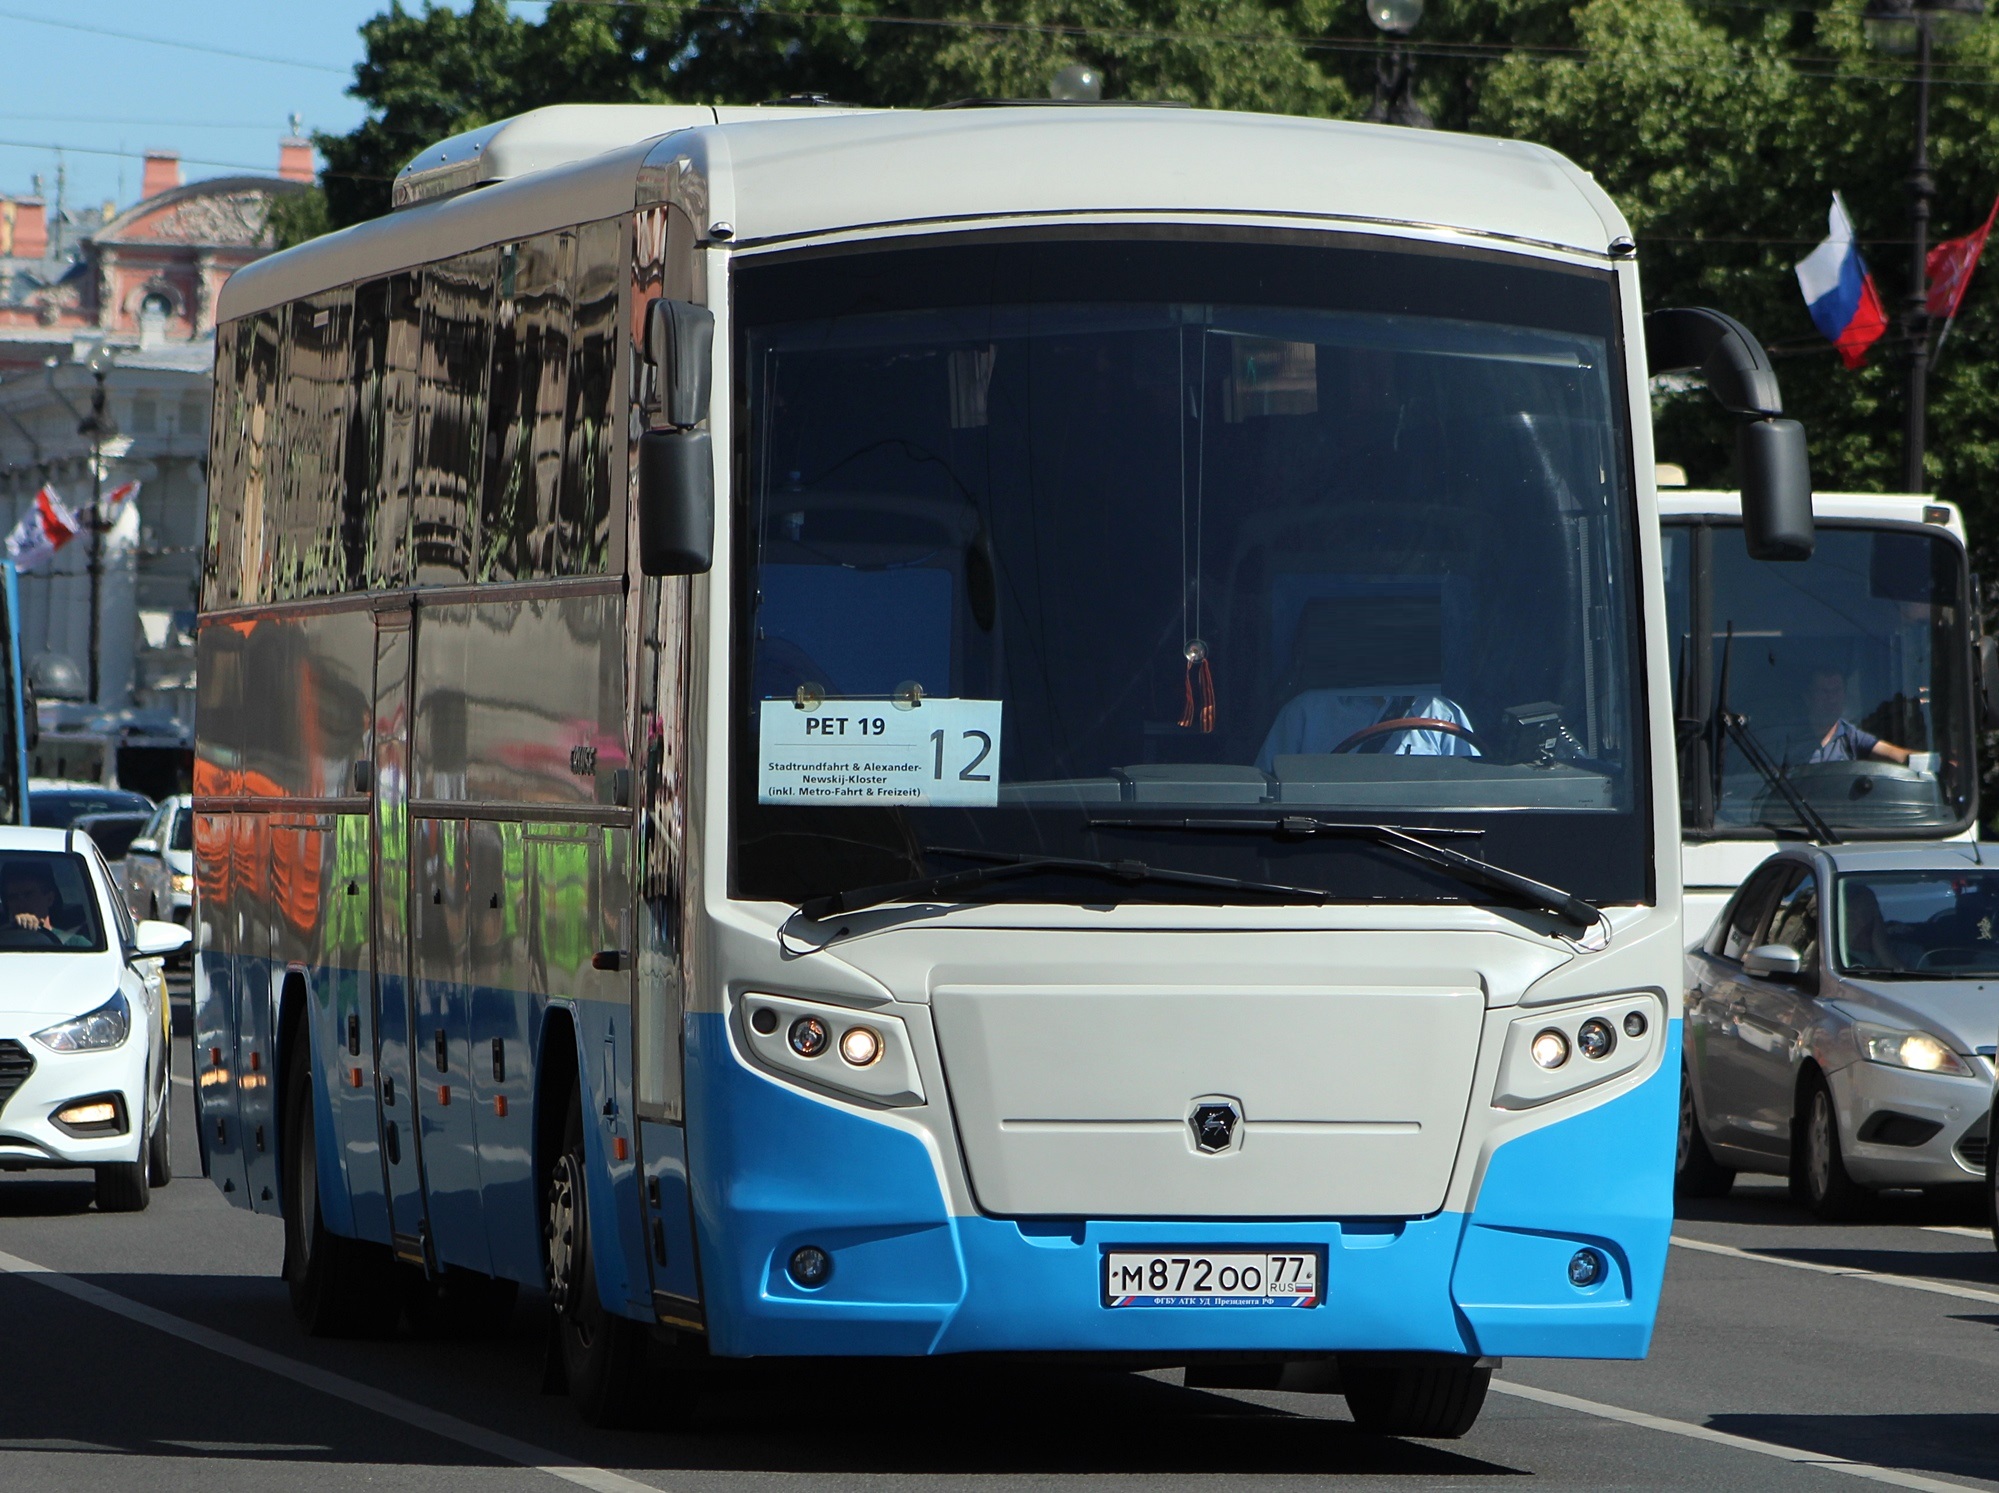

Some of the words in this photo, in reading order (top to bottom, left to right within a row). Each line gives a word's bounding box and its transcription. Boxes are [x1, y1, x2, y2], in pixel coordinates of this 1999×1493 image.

[806, 718, 848, 735] PET
[858, 718, 885, 735] 19
[929, 729, 992, 782] 12
[768, 762, 849, 771] Stadtrundfahrt
[853, 763, 860, 771] &
[864, 762, 922, 772] Alexander-
[803, 775, 887, 786] Newskij-Kloster
[768, 787, 795, 797] (inkl.
[799, 788, 863, 796] Metro-Fahrt
[877, 788, 921, 797] Freizeit)
[1272, 1257, 1303, 1282] 77
[1270, 1284, 1294, 1292] RUS
